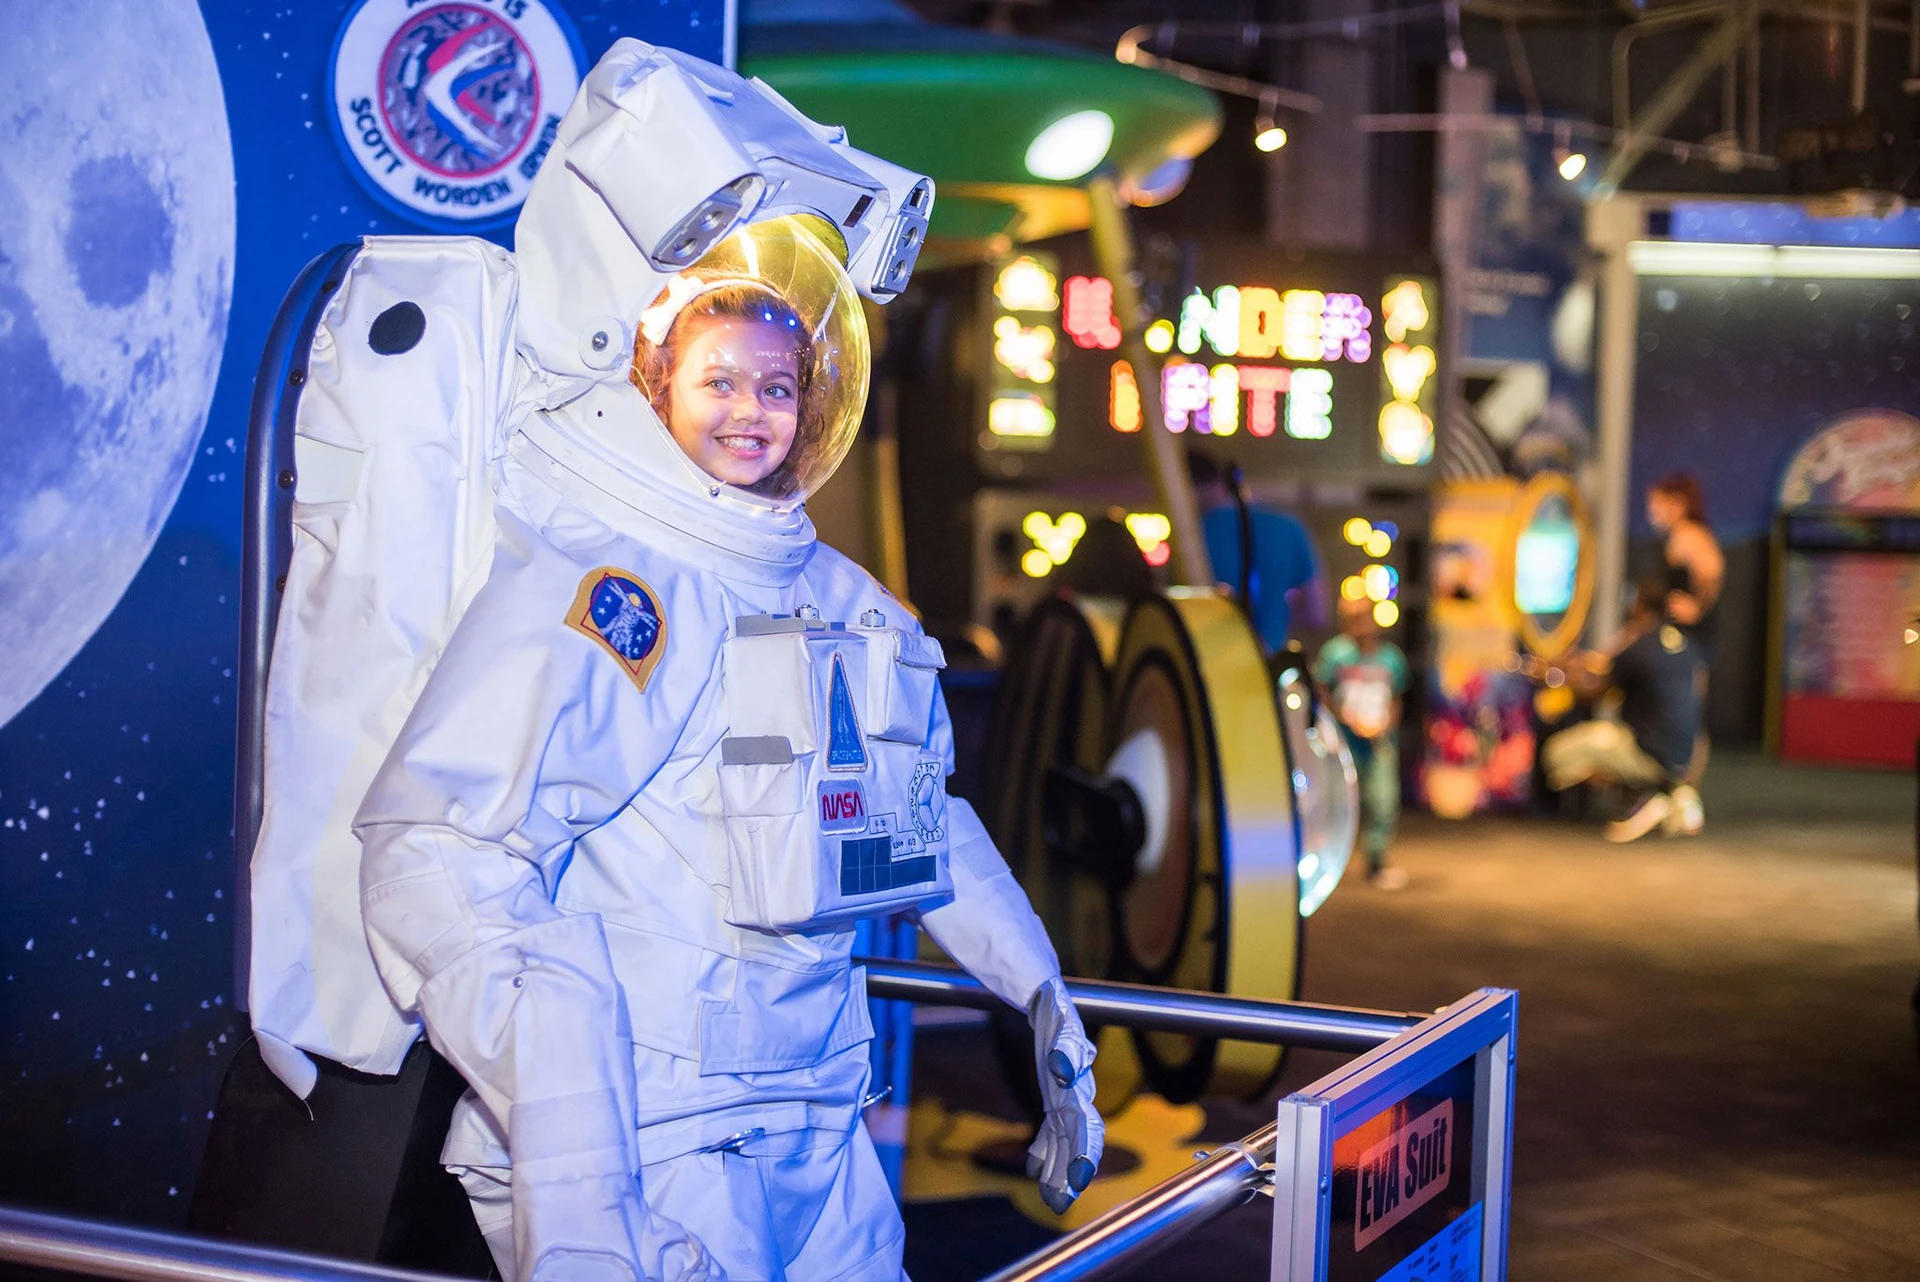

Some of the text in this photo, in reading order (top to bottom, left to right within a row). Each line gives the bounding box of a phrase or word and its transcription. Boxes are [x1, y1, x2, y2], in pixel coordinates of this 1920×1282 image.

[351, 97, 403, 174] SCOTT
[413, 177, 511, 206] WORDEN
[821, 790, 864, 821] NASA
[1359, 1143, 1400, 1232] EVA
[1405, 1117, 1448, 1199] Suit
